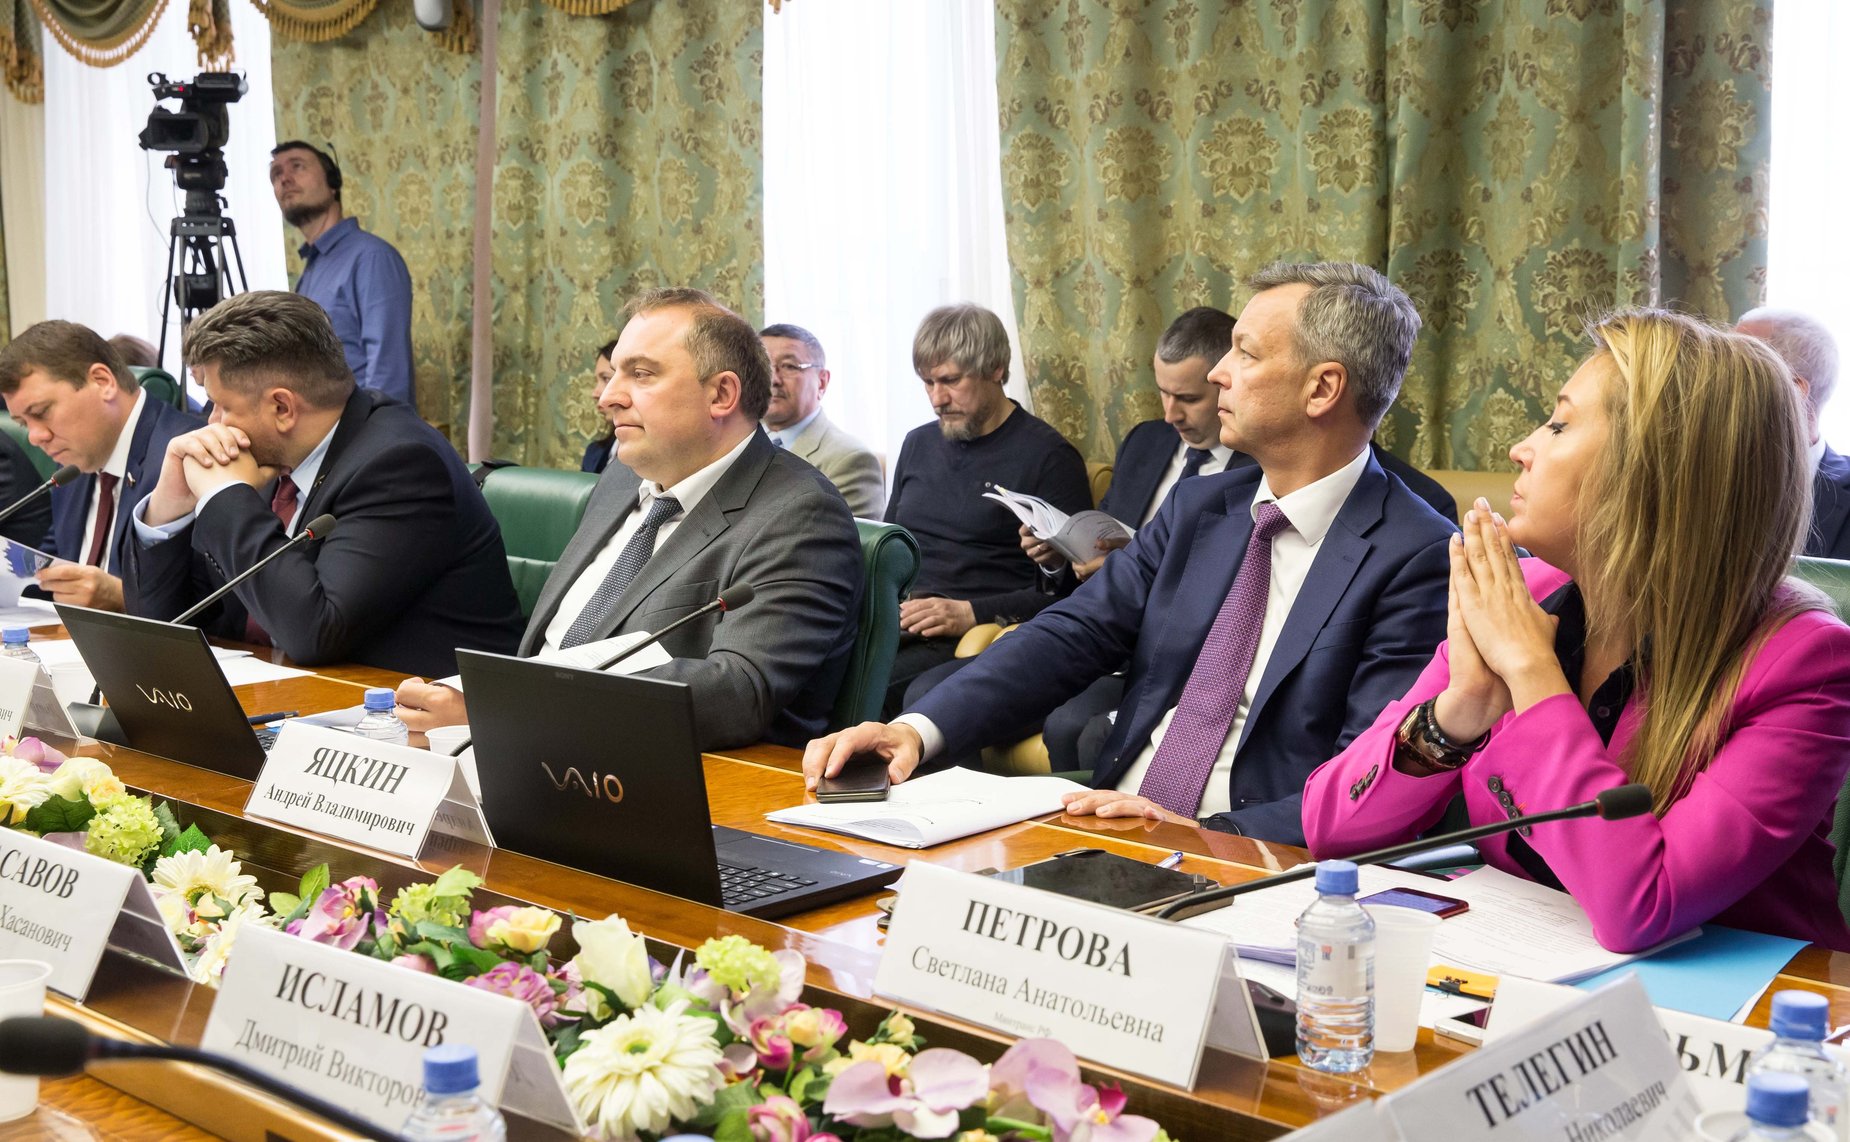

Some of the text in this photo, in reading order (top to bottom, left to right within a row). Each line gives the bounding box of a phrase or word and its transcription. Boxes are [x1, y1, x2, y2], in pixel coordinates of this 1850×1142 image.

[135, 683, 193, 712] VAIO
[303, 747, 411, 794] ЯЦКИН
[541, 761, 624, 803] VAIO
[263, 783, 416, 836] Андрей Владимирович
[0, 847, 80, 899] САВОВ
[0, 904, 73, 952] Хасанович
[960, 899, 1133, 978] ПЕТРОВА
[274, 963, 448, 1048] ИСЛАМОВ
[911, 945, 1165, 1043] Светлана Анатольевна
[235, 1019, 325, 1073] Дмитрий
[1465, 1020, 1620, 1130] ТЕЛЕГИН
[1564, 1080, 1670, 1142] Николаевич
